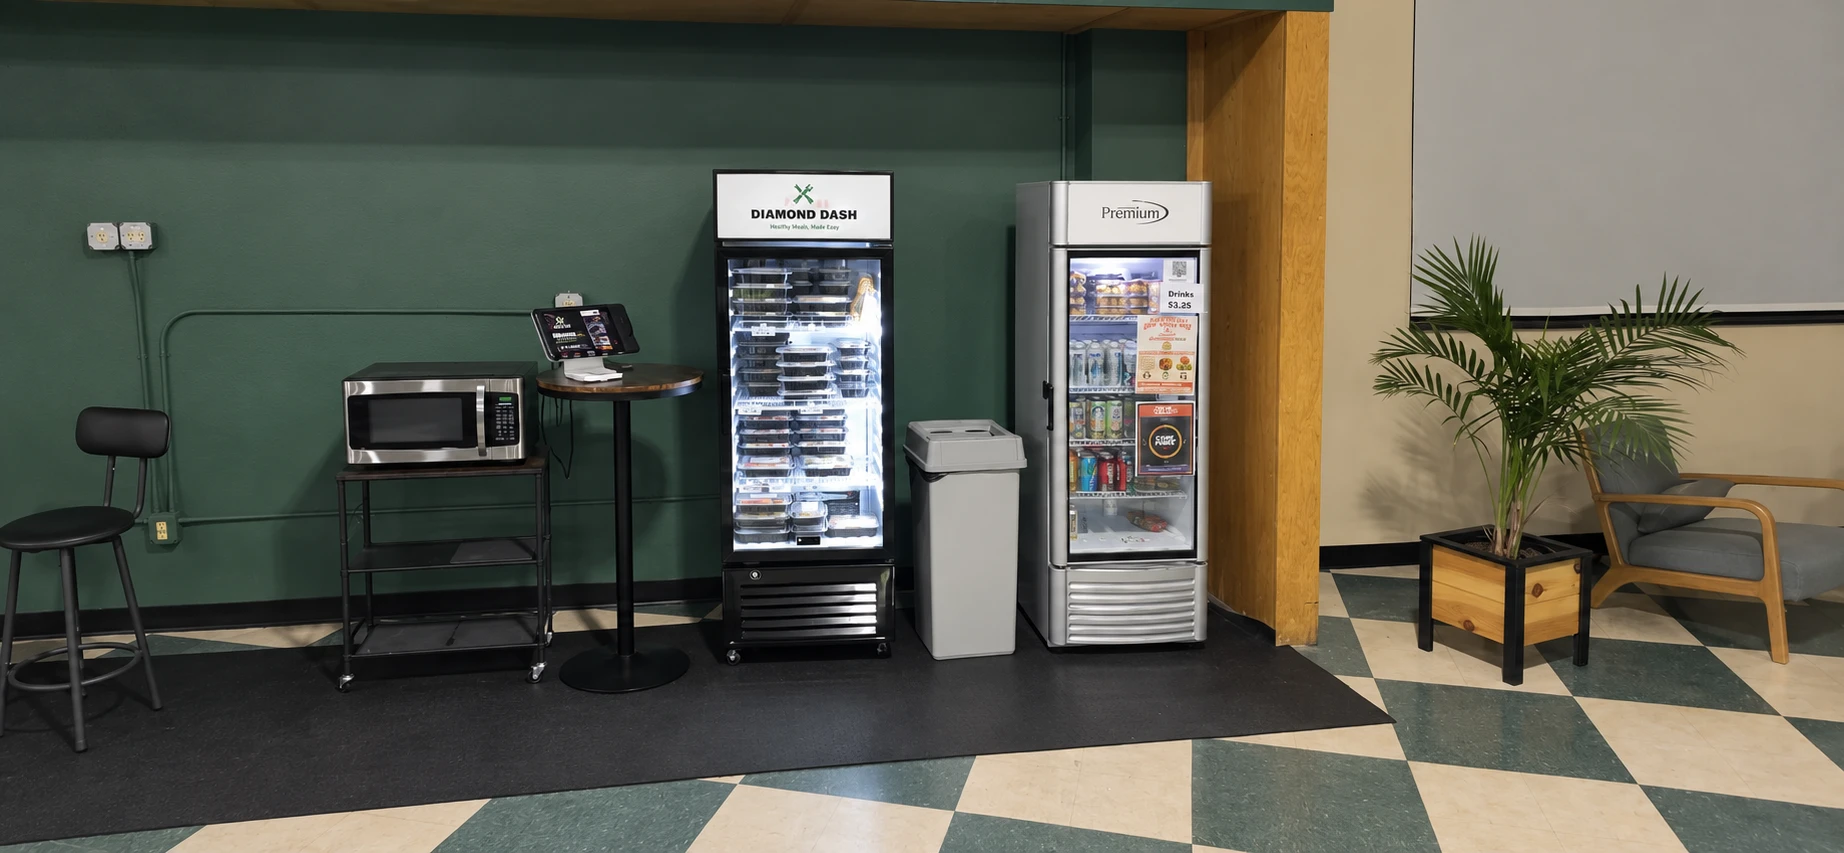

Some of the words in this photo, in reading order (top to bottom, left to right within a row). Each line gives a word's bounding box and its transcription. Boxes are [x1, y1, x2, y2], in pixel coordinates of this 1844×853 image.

[751, 209, 816, 220] DIAMOND
[820, 209, 857, 220] DASH
[1101, 206, 1160, 219] Premium
[1168, 290, 1194, 298] Drinks
